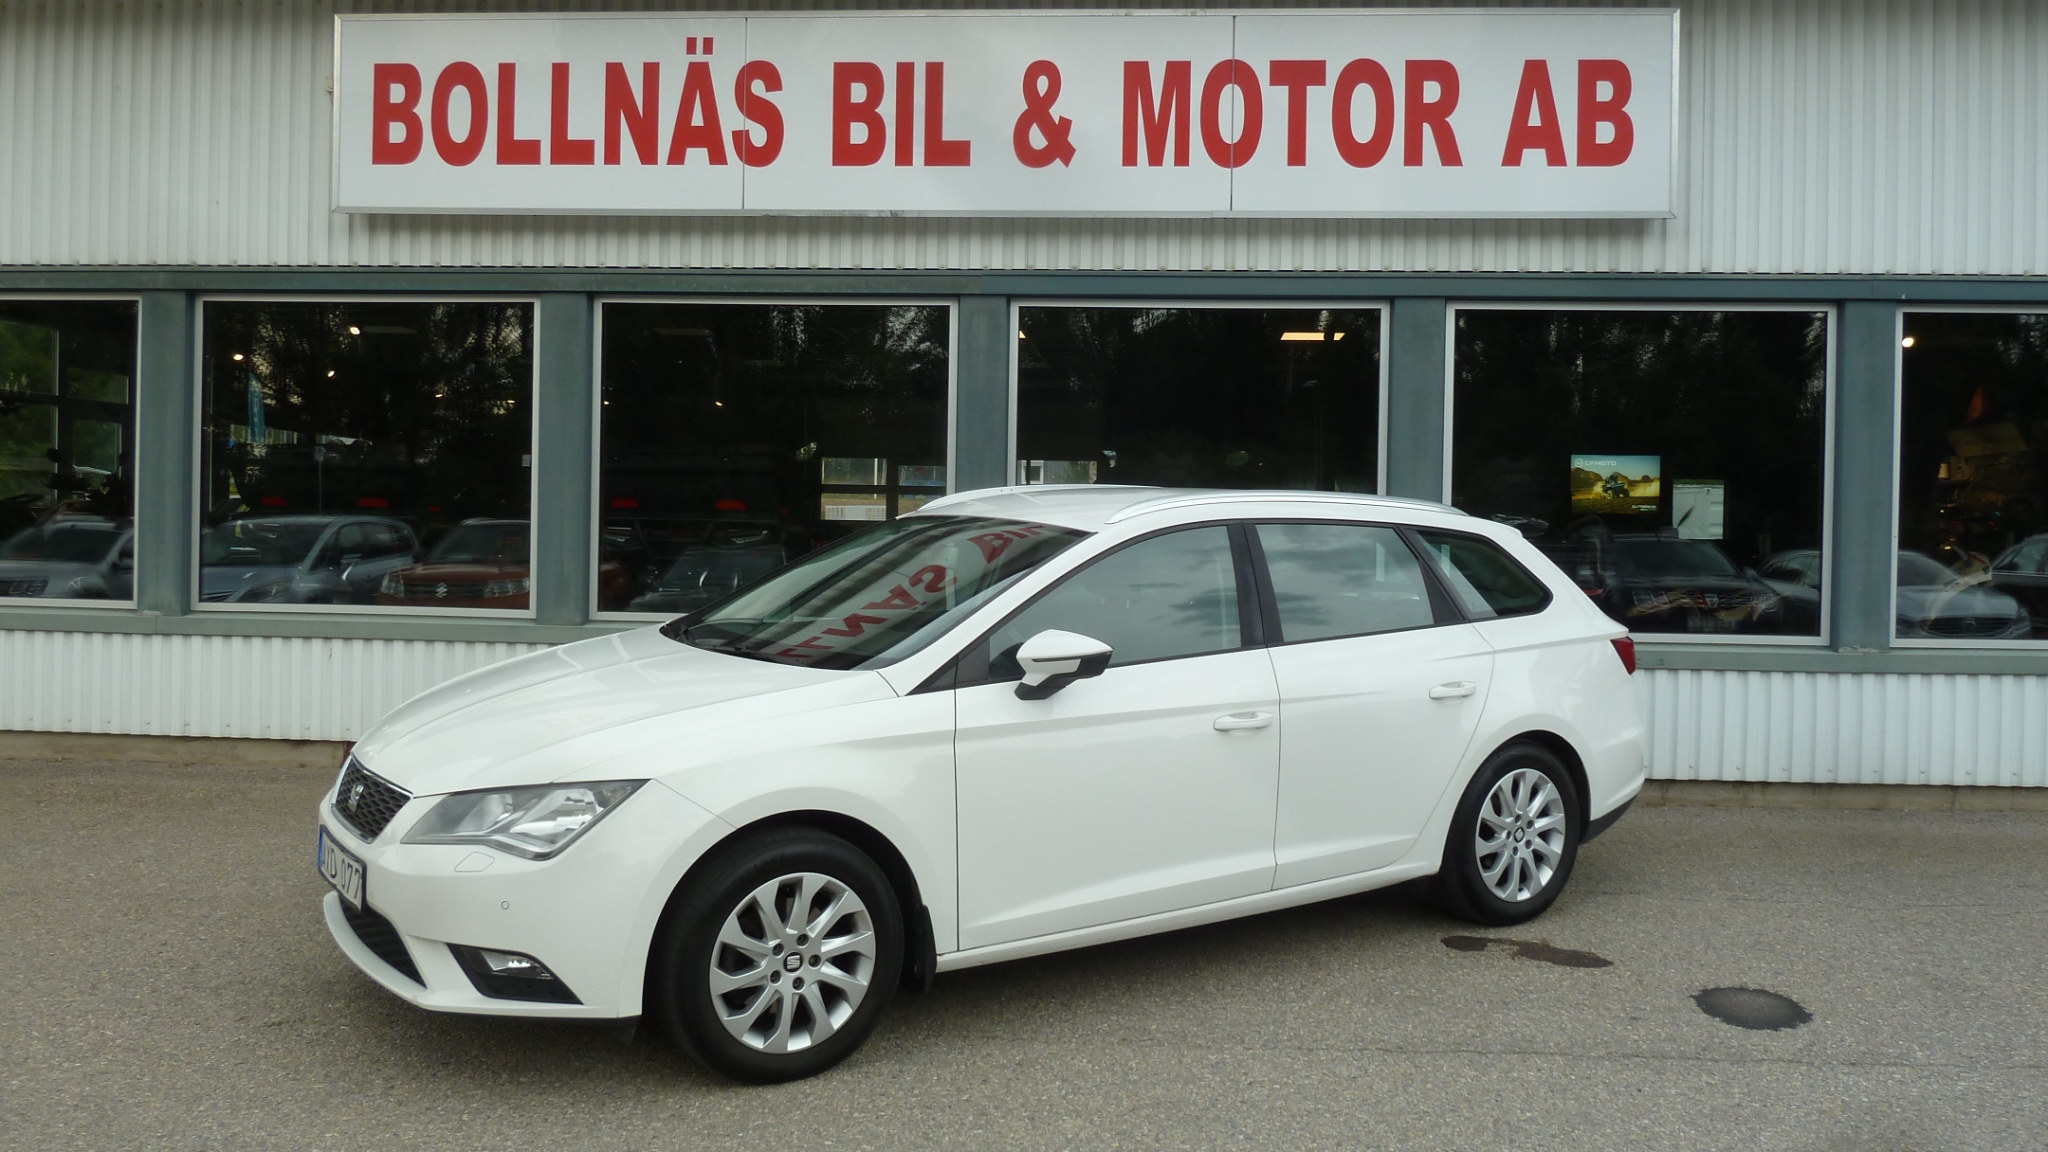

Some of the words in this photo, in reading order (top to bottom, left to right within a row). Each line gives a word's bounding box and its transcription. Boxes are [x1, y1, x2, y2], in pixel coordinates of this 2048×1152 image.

[371, 36, 785, 167] BOLLNÄS
[832, 61, 971, 167] BIL
[1013, 59, 1076, 168] &
[1122, 57, 1463, 169] MOTOR
[1501, 58, 1635, 168] AB
[341, 858, 360, 899] 077
